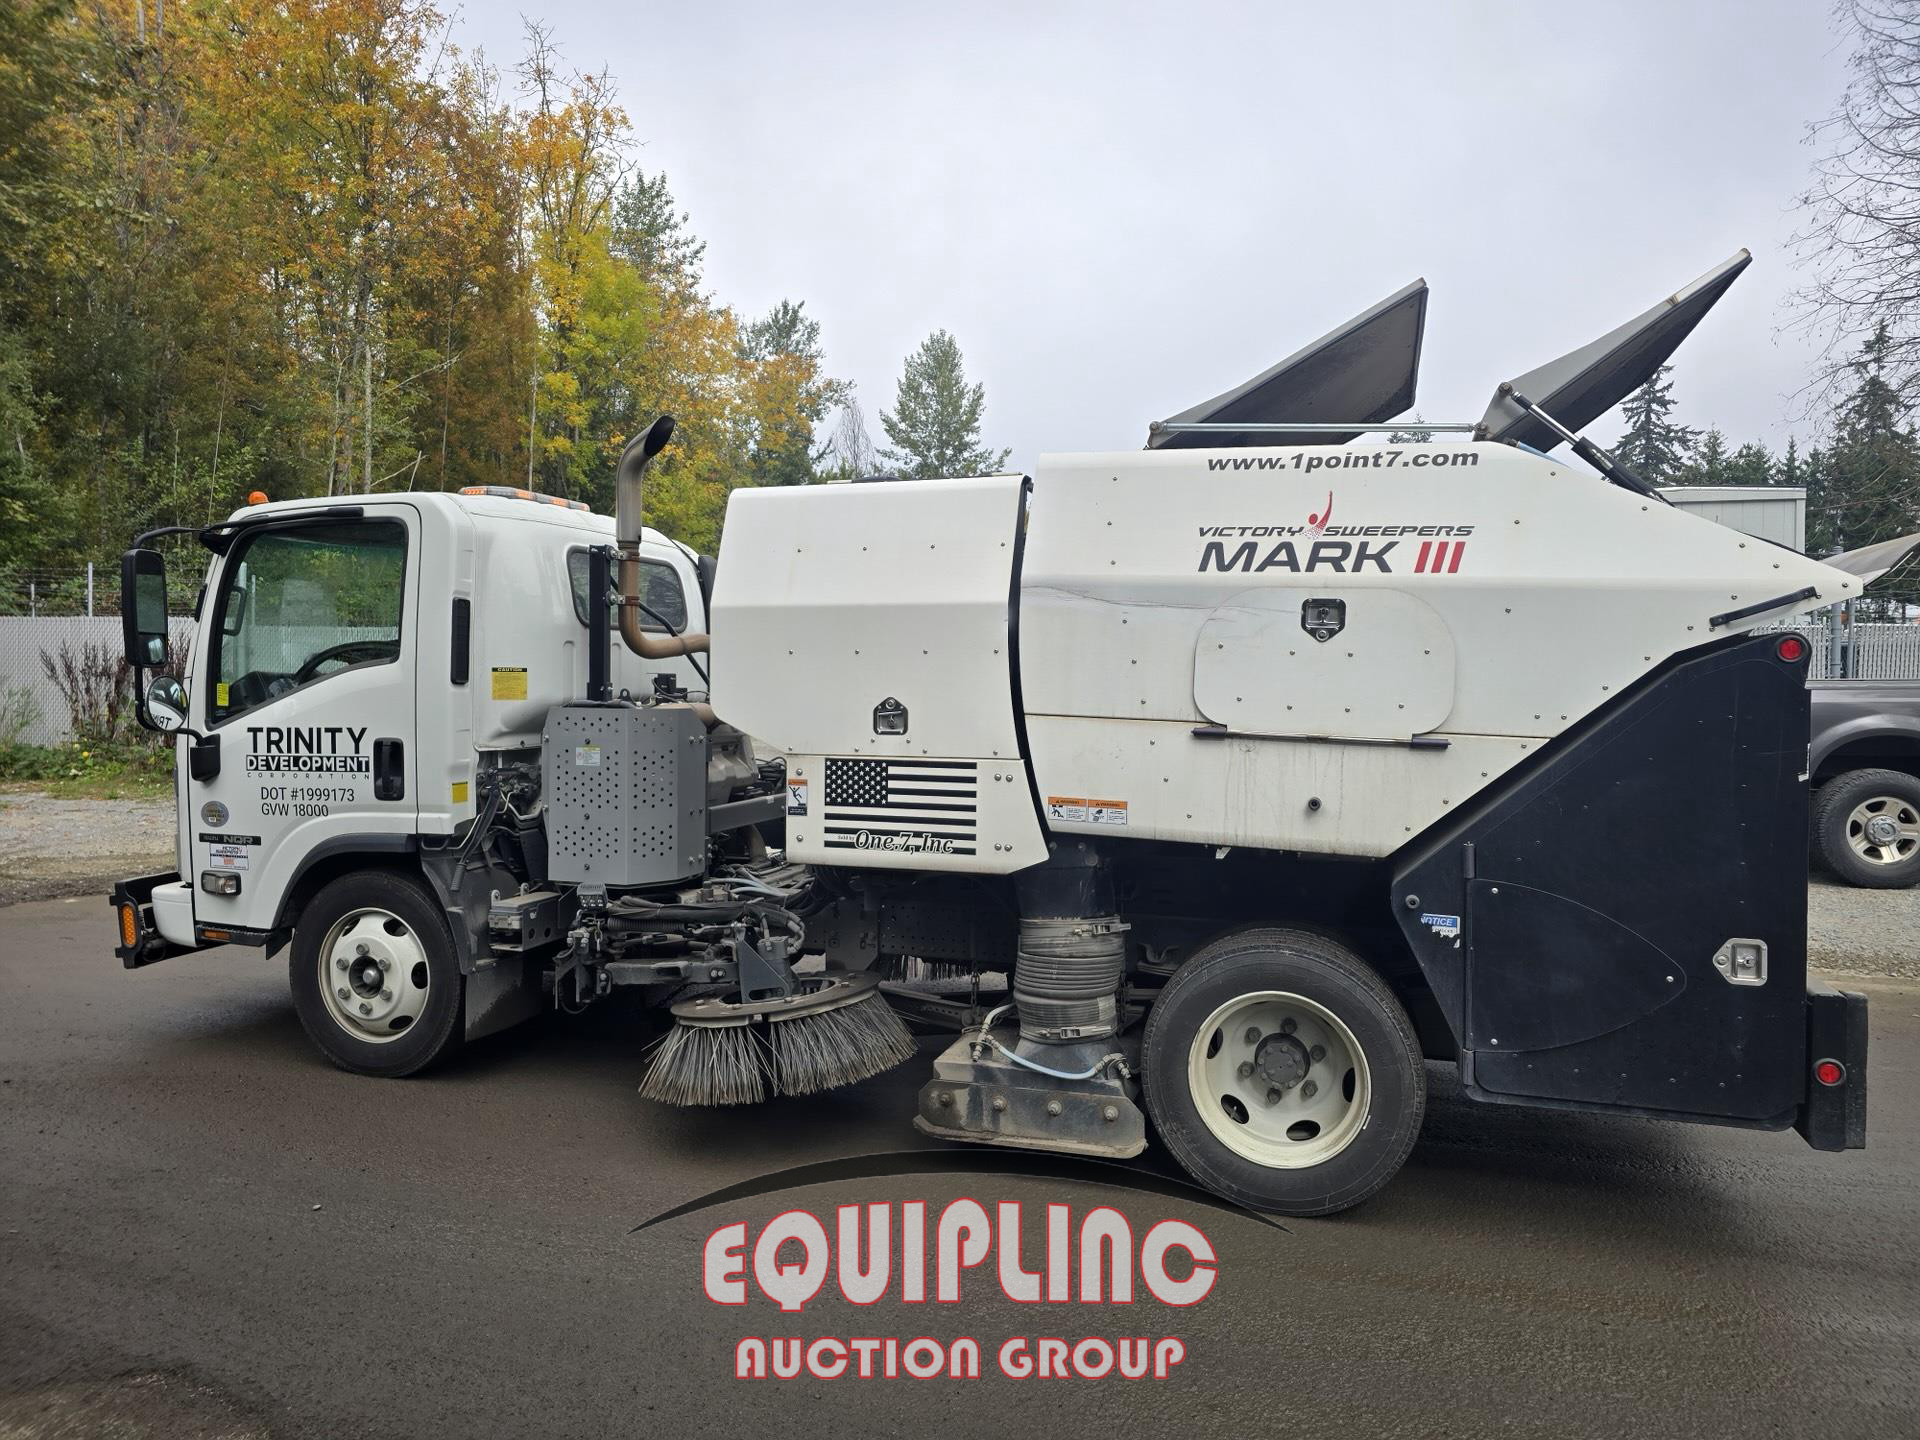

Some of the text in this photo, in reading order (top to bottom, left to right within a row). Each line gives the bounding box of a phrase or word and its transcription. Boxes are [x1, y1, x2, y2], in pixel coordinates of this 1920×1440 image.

[1208, 451, 1479, 473] www.1point7.com
[1199, 525, 1475, 537] VICTORY SWEEPERS
[1198, 541, 1466, 573] MARK III
[247, 727, 368, 755] TRINITY
[247, 756, 369, 771] DEVELOPMENT
[247, 772, 369, 780] CORPORATION
[261, 787, 355, 802] DOT #1999173
[261, 803, 329, 817] GVW 18000
[918, 832, 954, 853] Inc
